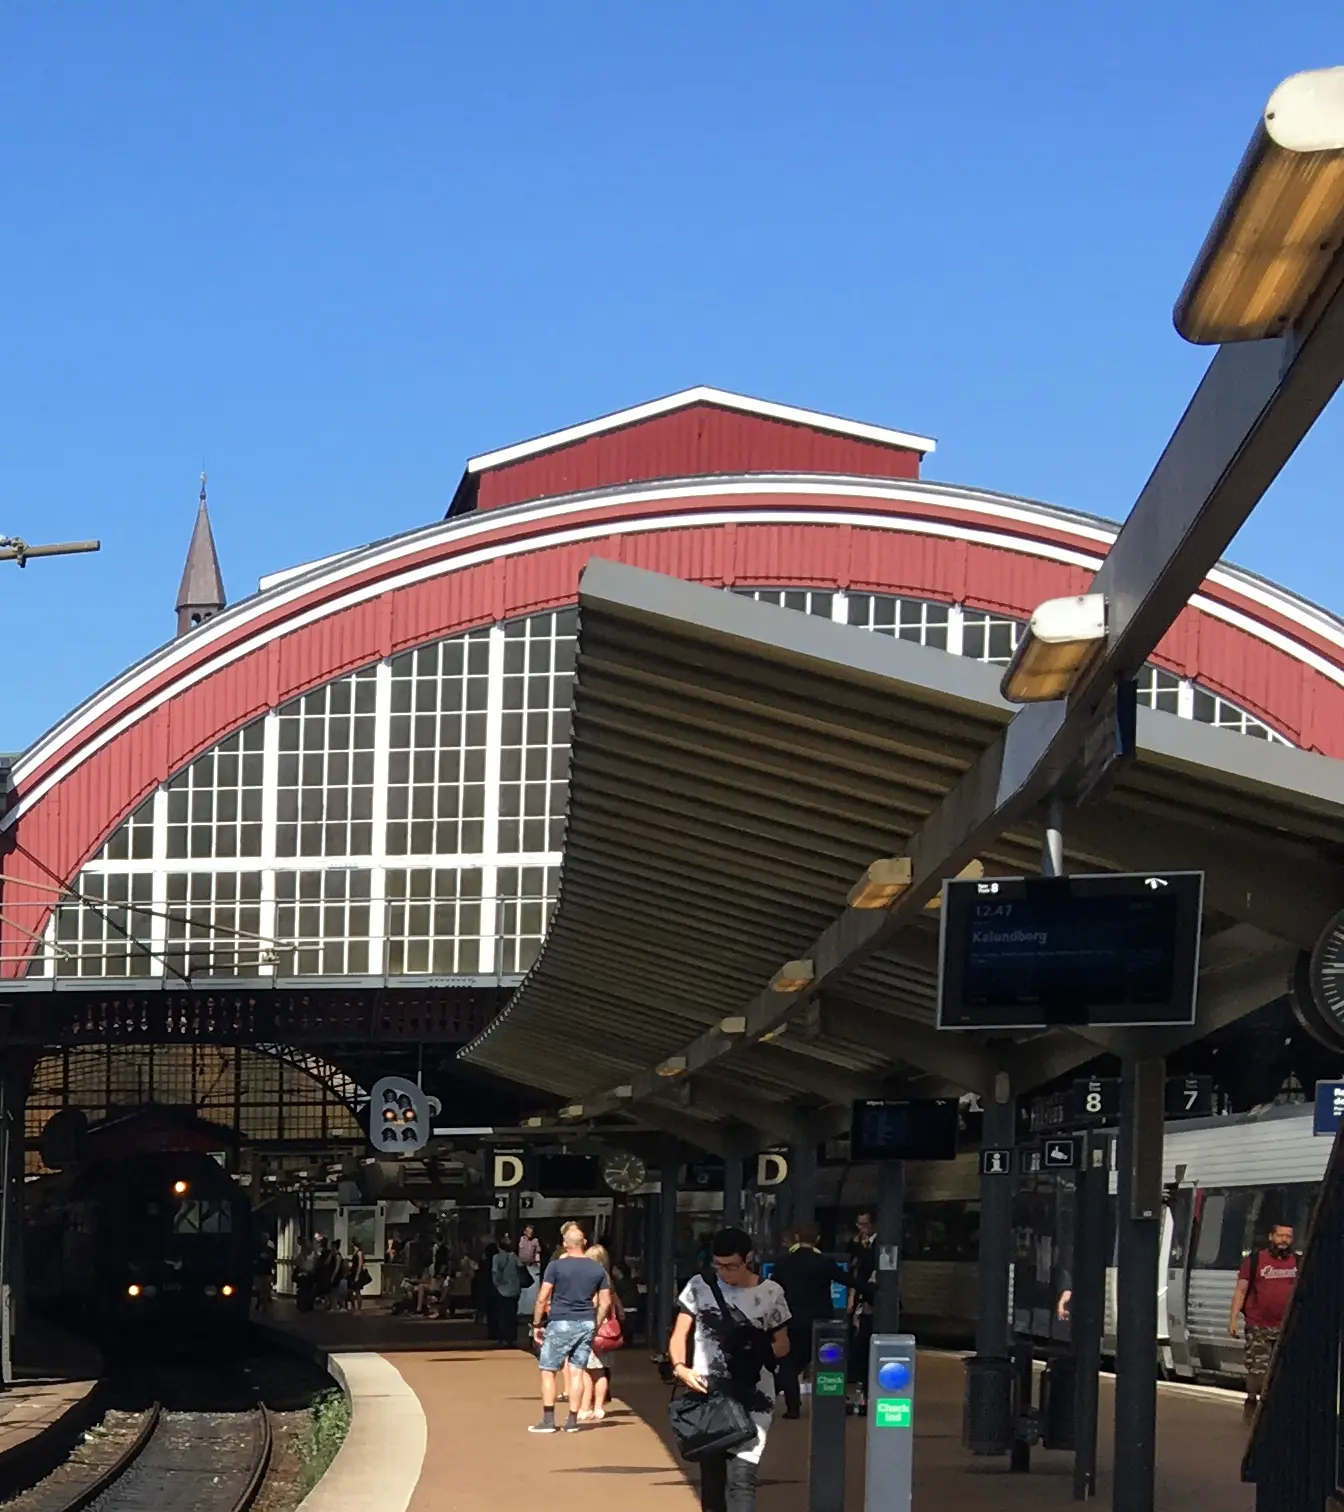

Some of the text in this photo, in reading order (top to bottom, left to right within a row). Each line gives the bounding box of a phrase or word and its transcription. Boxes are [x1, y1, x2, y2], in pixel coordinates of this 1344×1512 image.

[975, 905, 1012, 917] 12.47
[972, 929, 1048, 945] Kalundborg
[1086, 1093, 1101, 1113] 8
[1183, 1090, 1198, 1110] 7
[494, 1155, 524, 1187] D
[757, 1154, 788, 1186] D
[878, 1403, 911, 1413] Check
